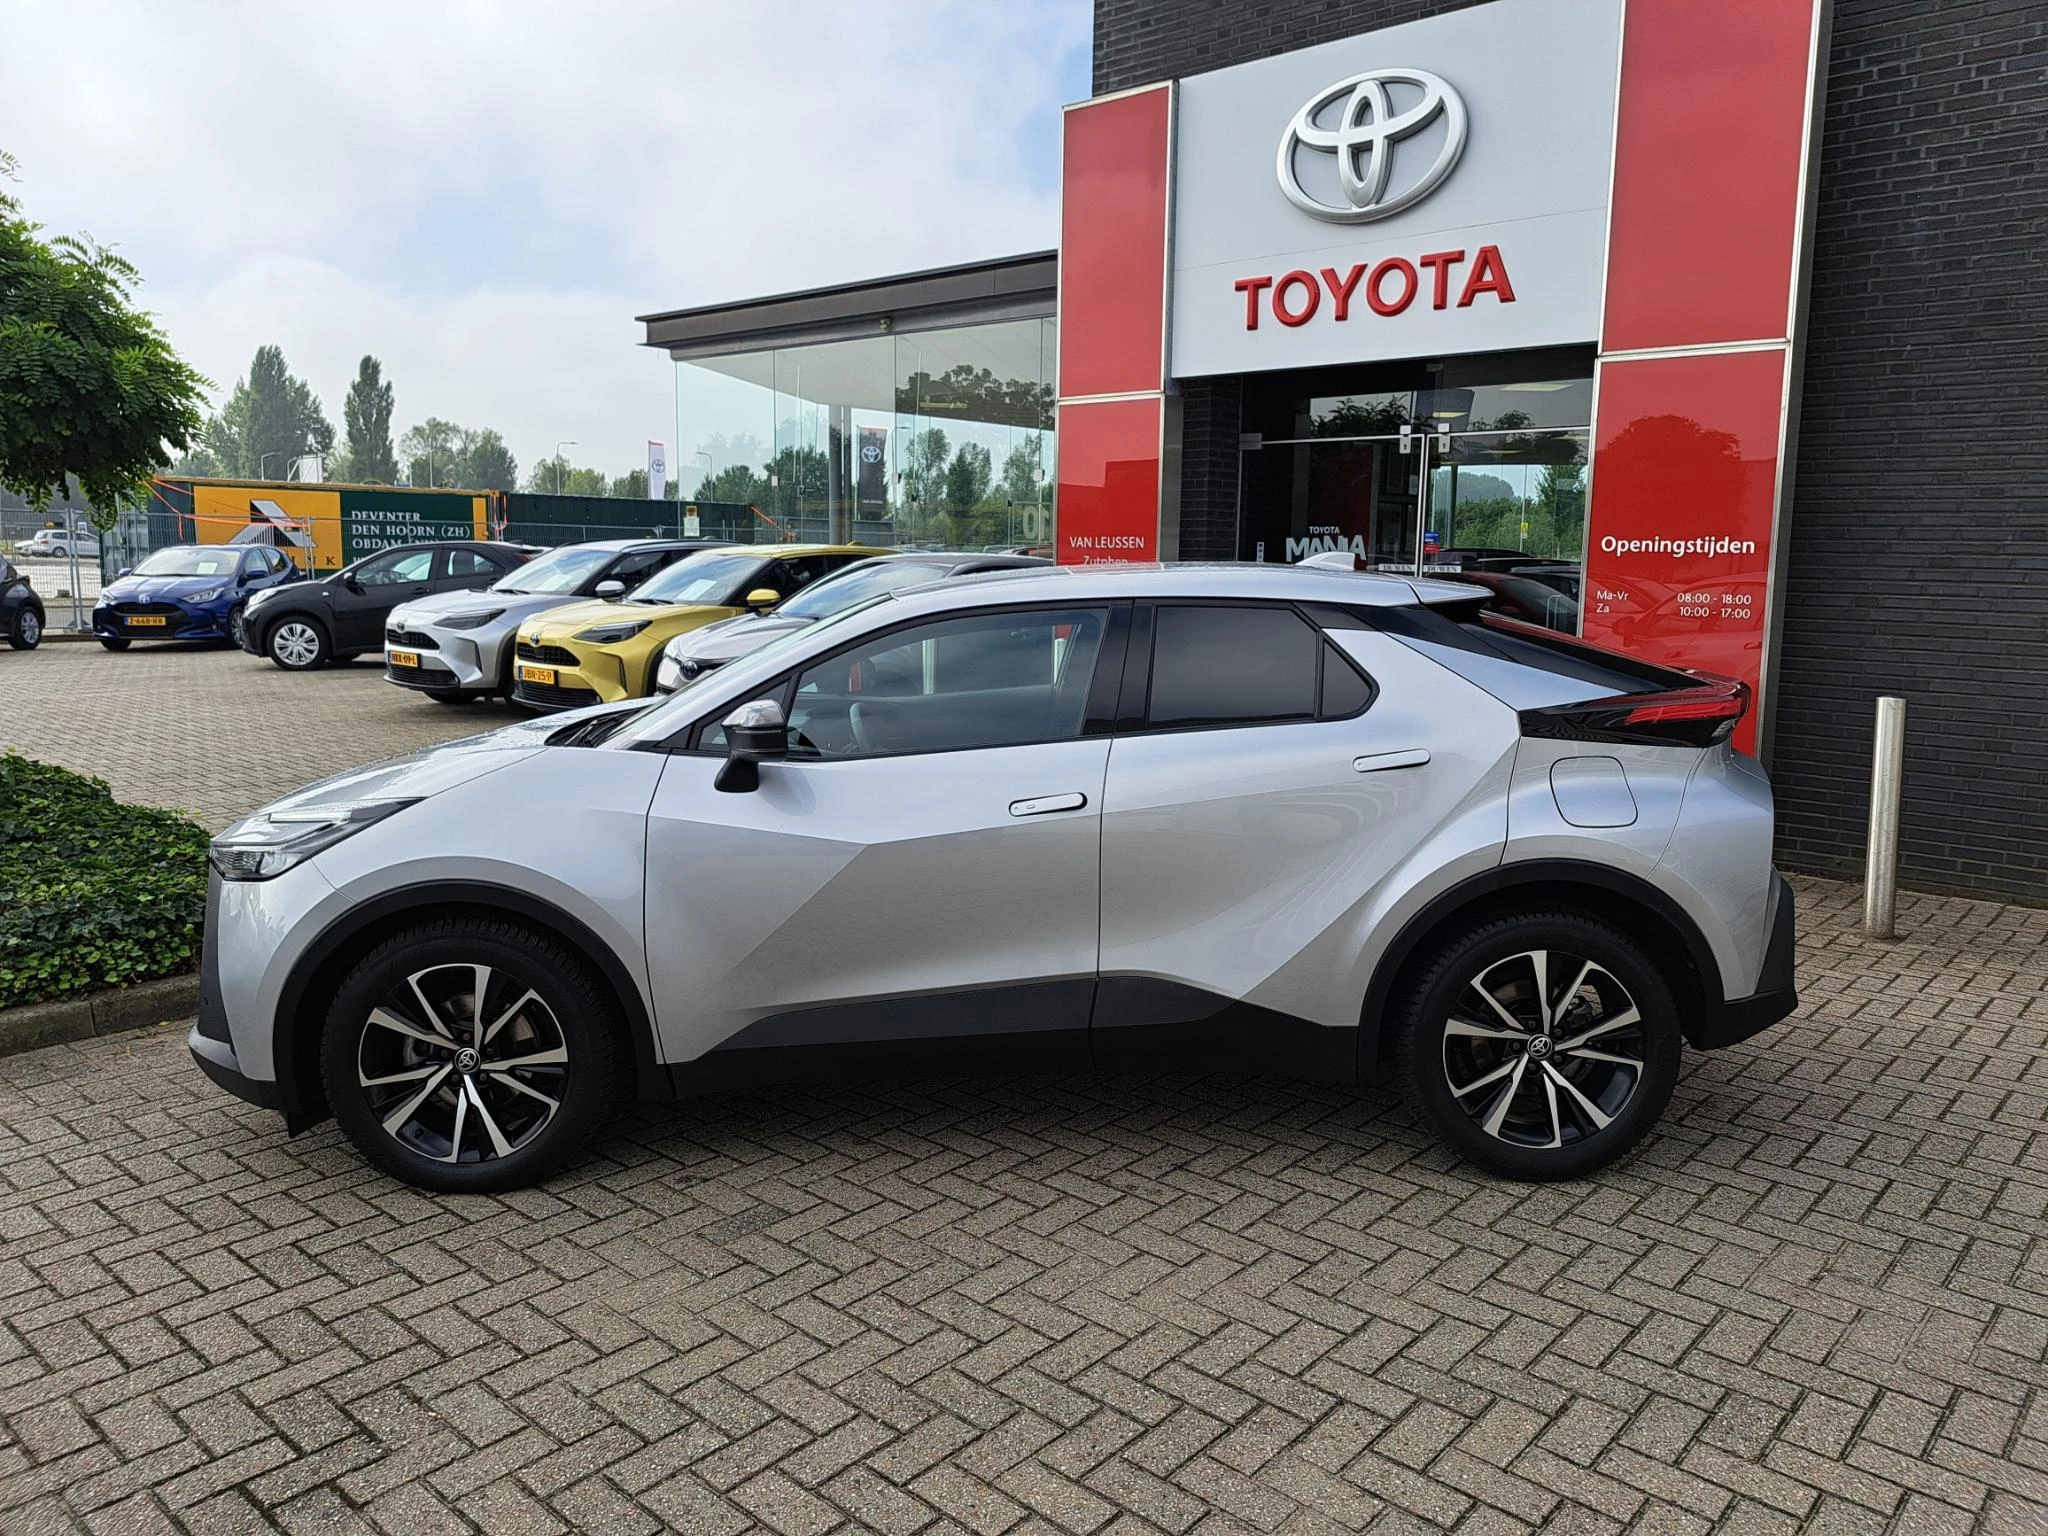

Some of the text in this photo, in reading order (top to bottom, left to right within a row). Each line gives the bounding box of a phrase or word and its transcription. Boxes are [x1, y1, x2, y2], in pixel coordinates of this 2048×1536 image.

[1235, 244, 1517, 331] TOYOTA
[351, 510, 421, 521] DEVENTER
[351, 524, 470, 538] DEN HOORN (ZH)
[1308, 526, 1340, 535] TOYOTA
[352, 538, 402, 549] OBDAM
[1069, 536, 1145, 549] VAN LEUSSEN
[1285, 534, 1367, 562] MANIA
[1601, 536, 1755, 558] Openingstijden
[1596, 590, 1629, 600] Ma-Vr
[1677, 592, 1711, 604] 08:00
[1721, 594, 1752, 605] 18:00
[1596, 604, 1610, 613] Za
[1679, 606, 1709, 617] 10:00
[1721, 608, 1751, 619] 17:00
